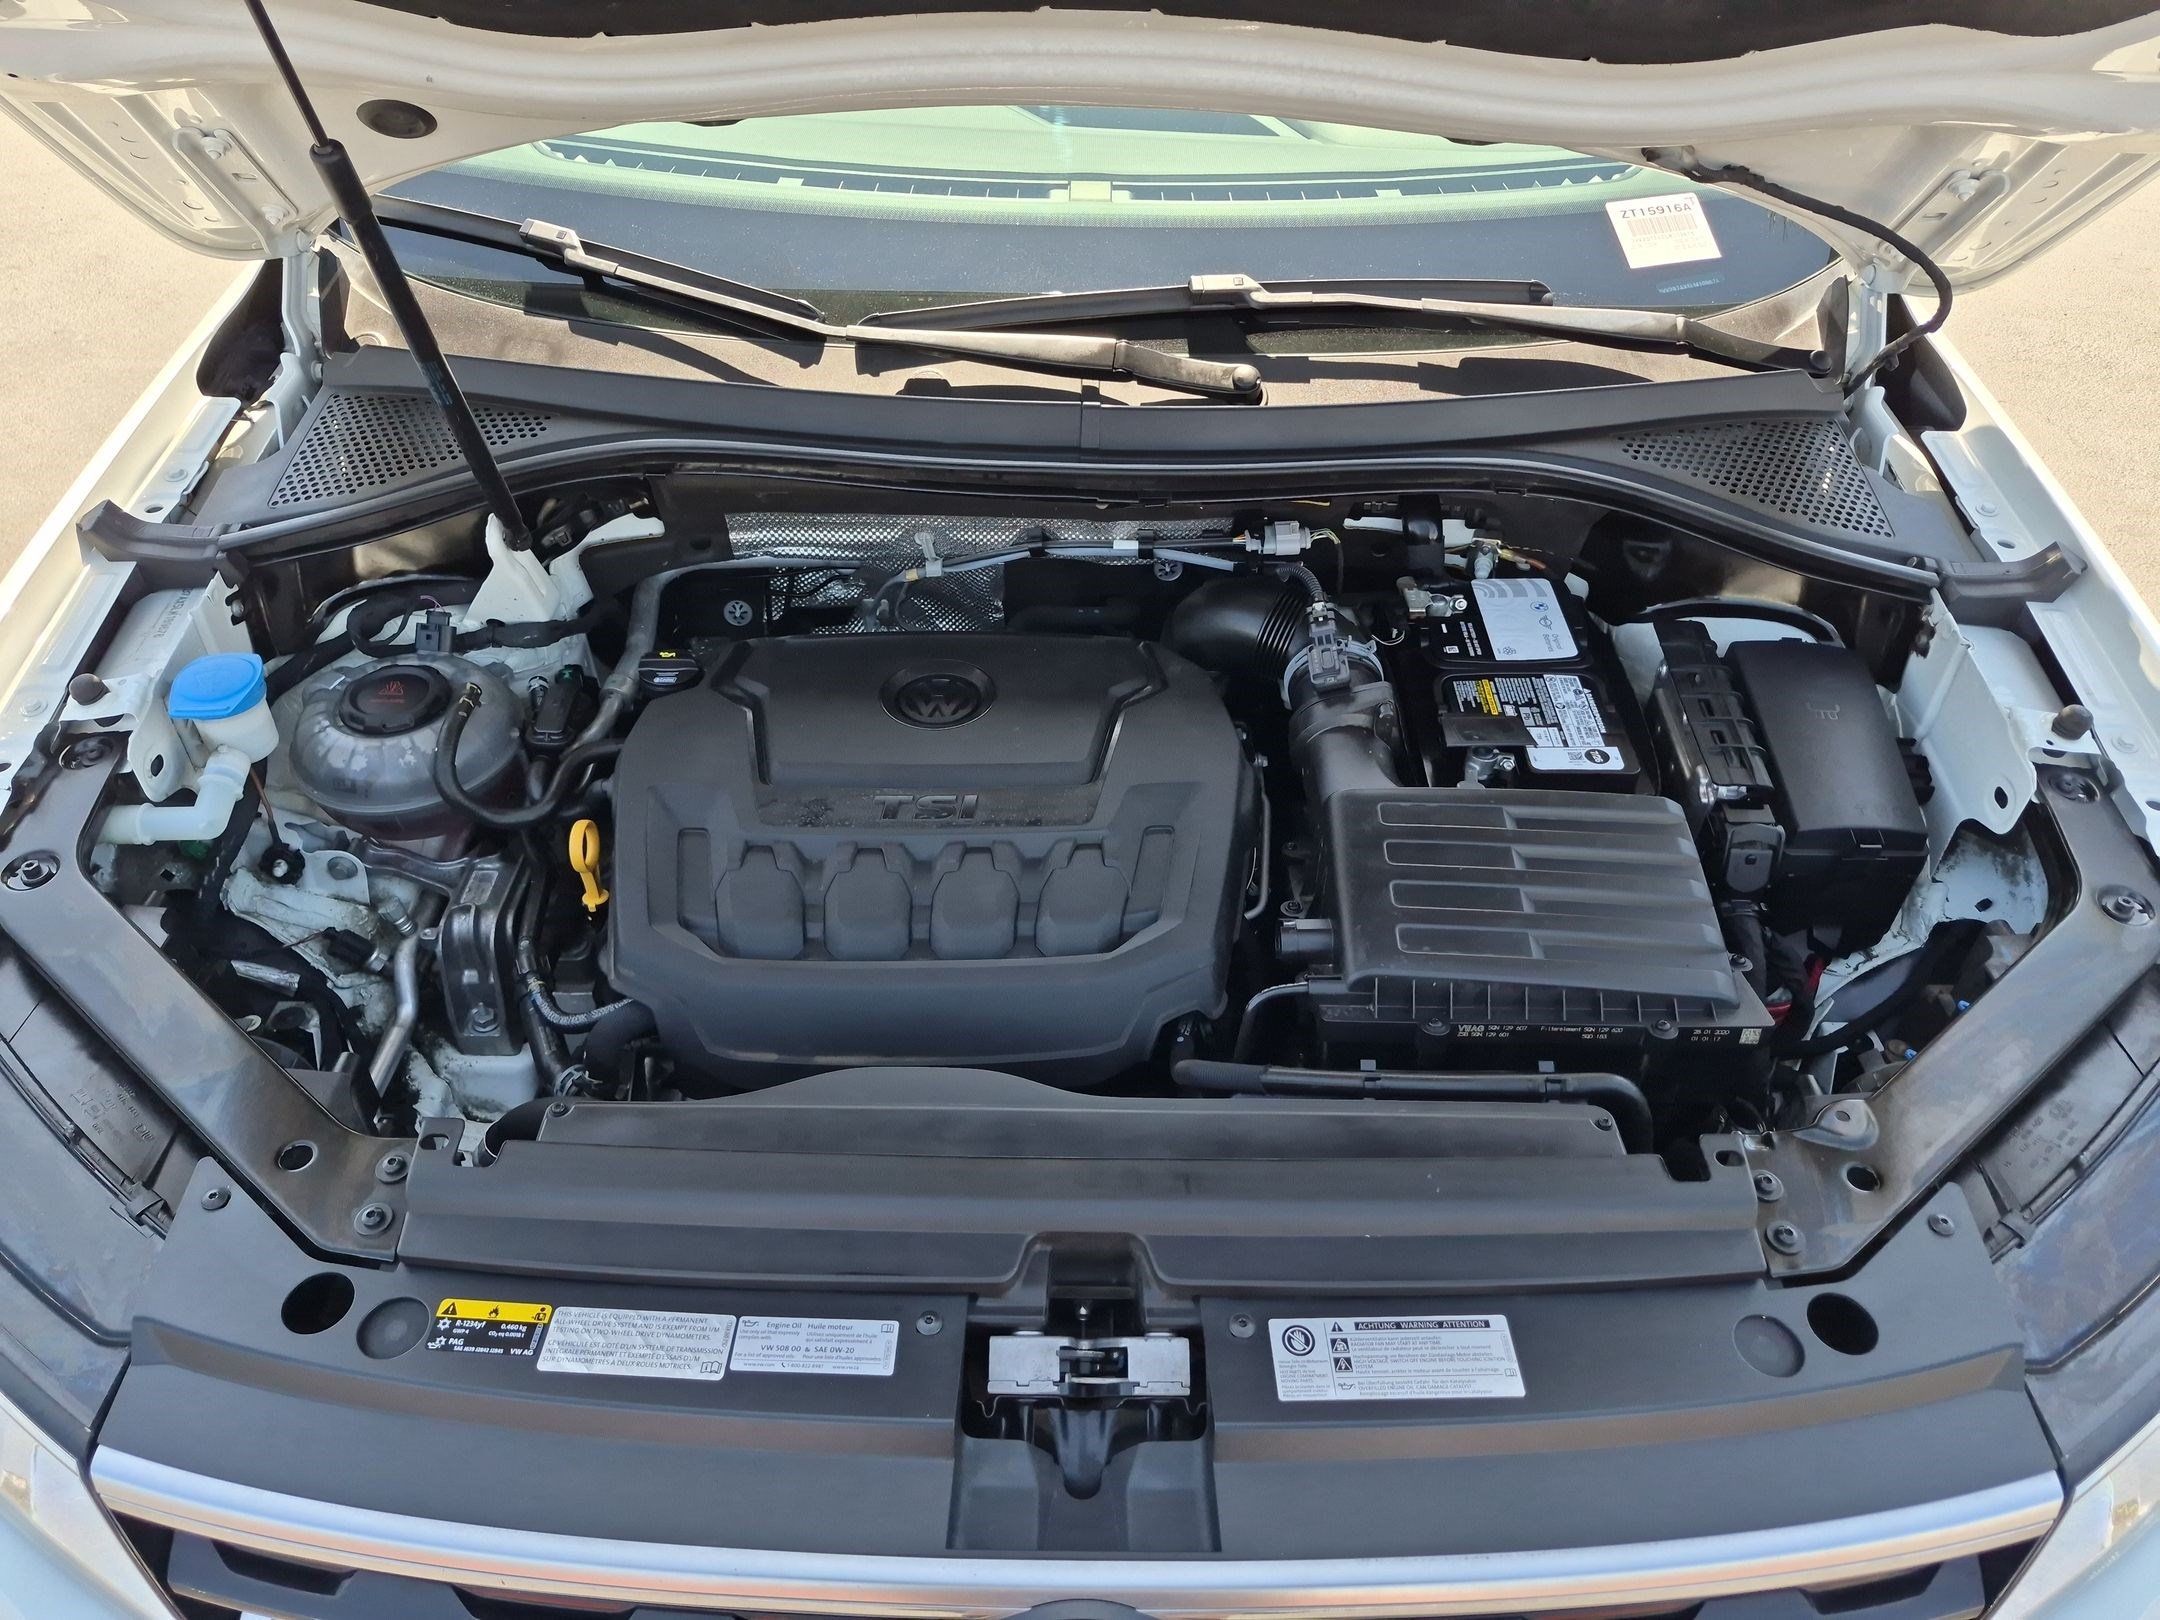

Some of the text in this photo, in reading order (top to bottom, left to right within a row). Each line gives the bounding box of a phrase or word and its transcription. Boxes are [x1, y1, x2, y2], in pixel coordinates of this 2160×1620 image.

[1620, 202, 1692, 219] ZT15916A
[1522, 713, 1531, 721] Pb
[873, 794, 979, 820] TSI
[554, 1317, 590, 1326] ALL-WHEEL
[661, 1323, 687, 1331] EXEMPT
[667, 1316, 707, 1324] PERMANENT
[455, 1319, 486, 1330] R-1234yf
[519, 1324, 527, 1332] kg
[766, 1321, 790, 1330] Engine
[1358, 1320, 1485, 1330] ACHTUNG WARNING ATTENTION
[592, 1328, 633, 1336] TWO-WHEEL
[634, 1330, 654, 1338] DRIVE
[448, 1337, 464, 1345] PAG
[510, 1347, 522, 1355] VW
[580, 1349, 618, 1357] PERMANENT
[676, 1346, 723, 1354] TRANSMISSION
